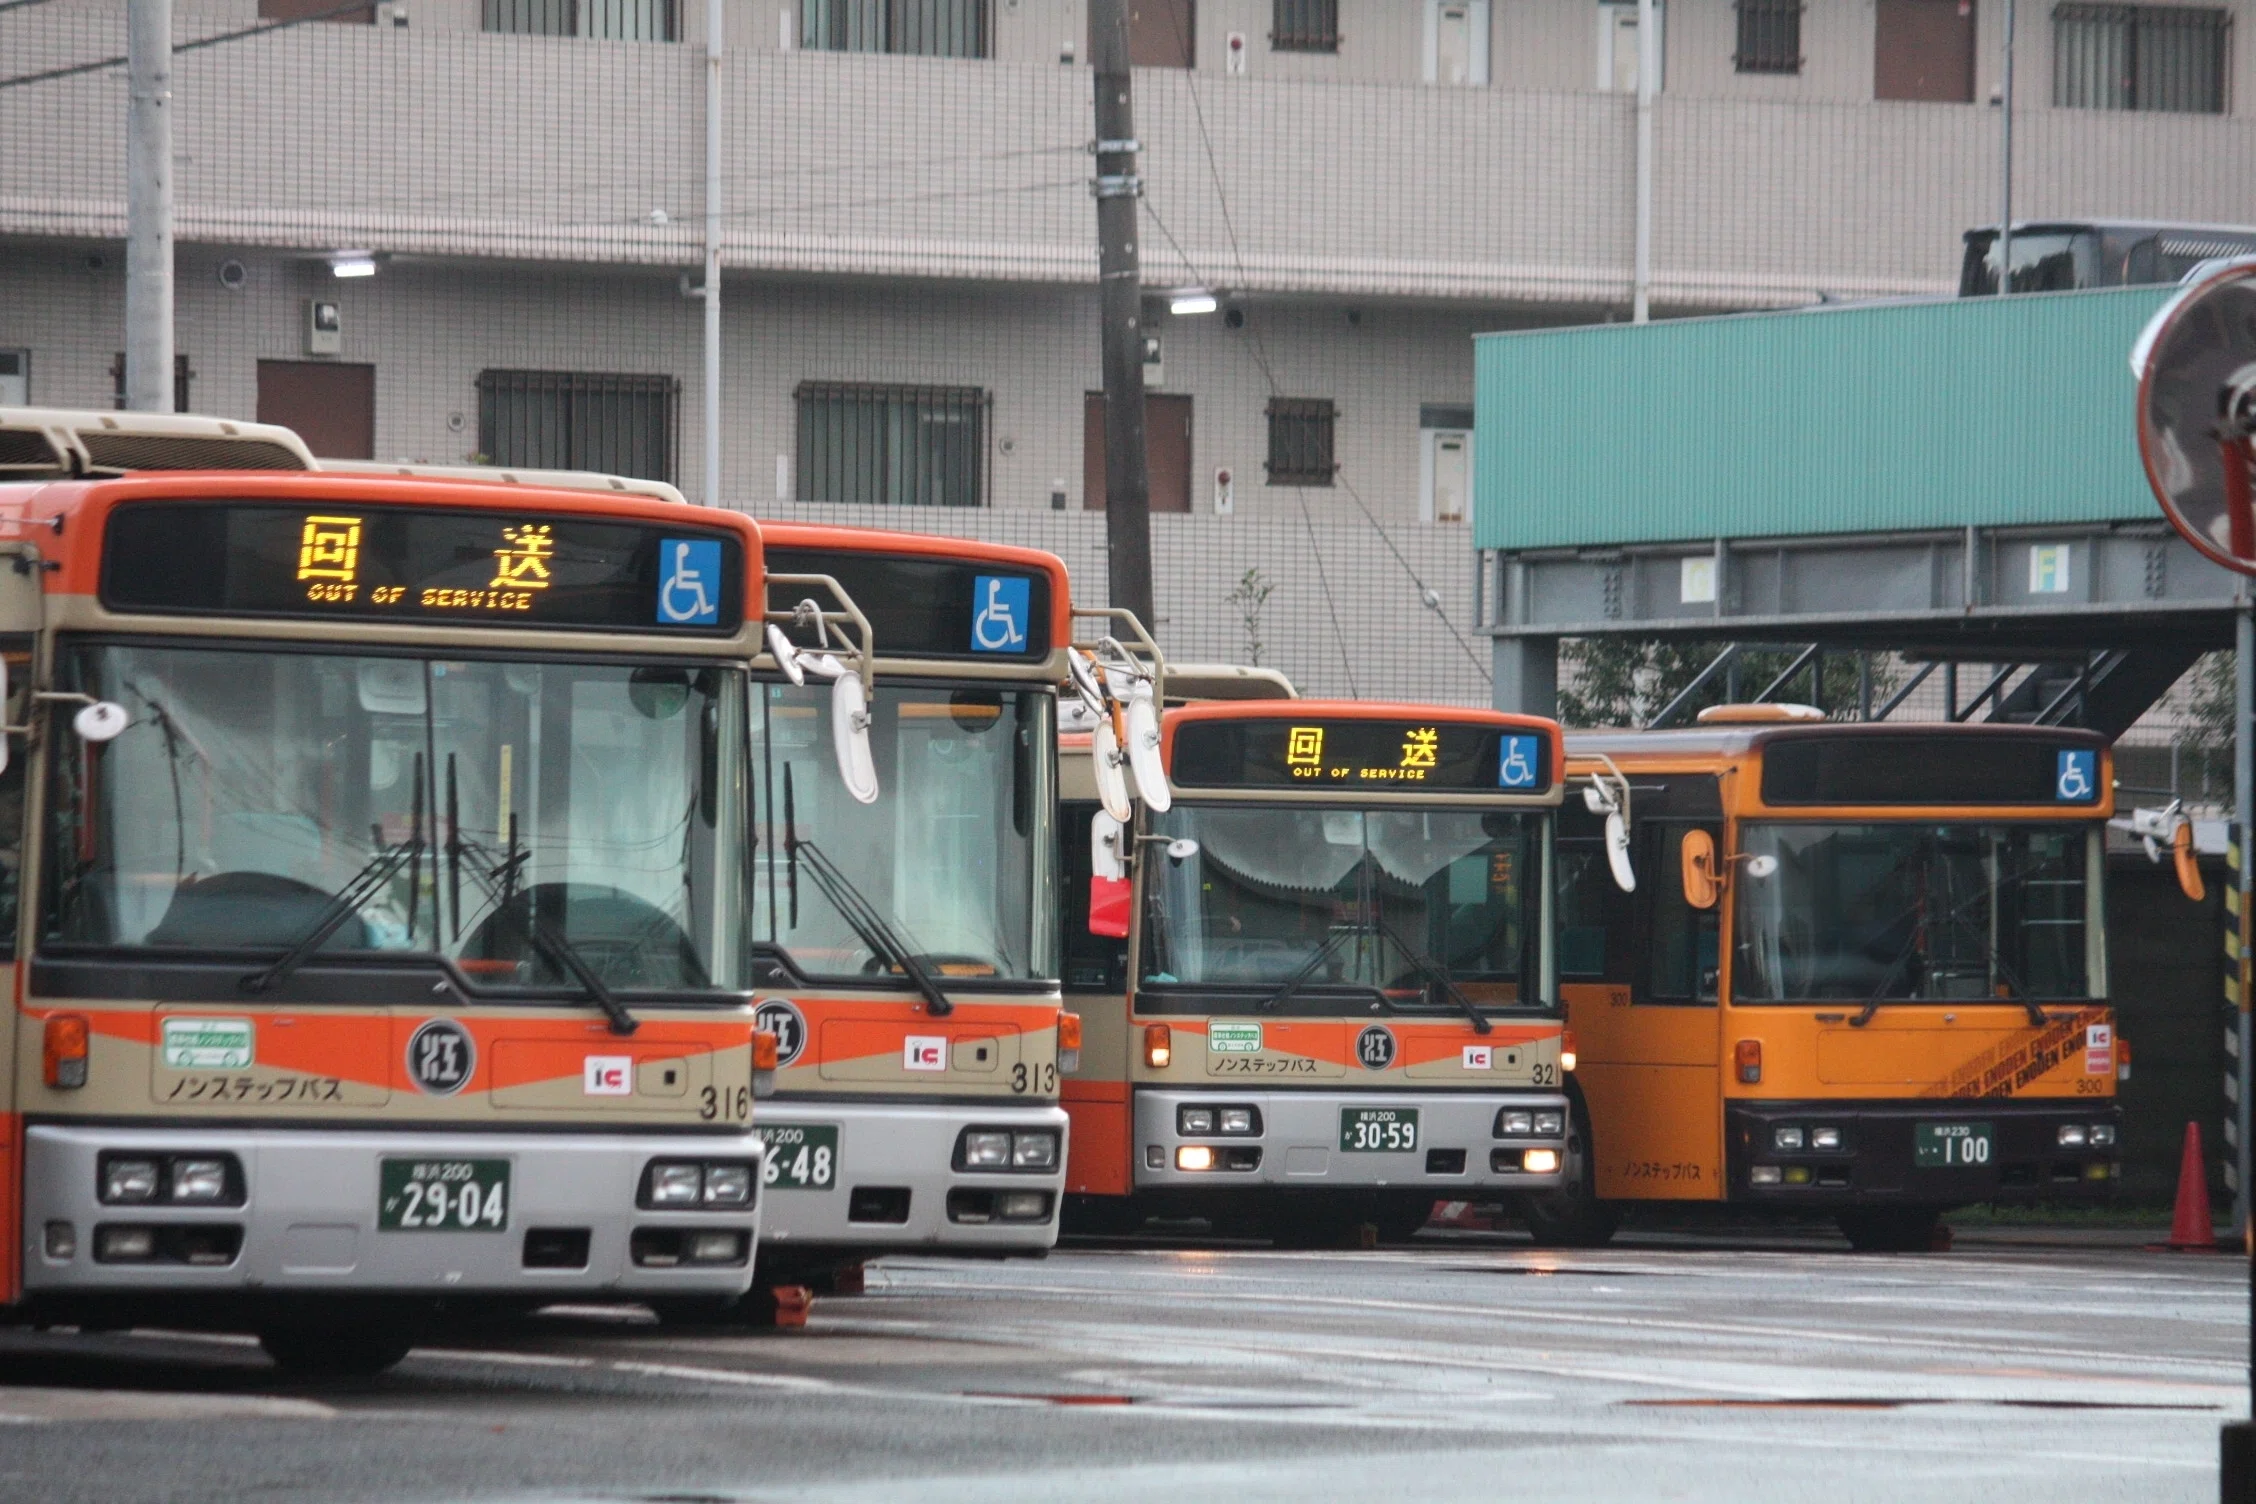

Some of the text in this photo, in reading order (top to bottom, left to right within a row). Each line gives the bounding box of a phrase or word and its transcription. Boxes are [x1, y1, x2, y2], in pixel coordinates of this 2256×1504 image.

[307, 583, 531, 610] OUT OF SERVICE
[1293, 767, 1425, 780] OUT OF SERVICE
[1011, 1063, 1055, 1093] 313
[1215, 1058, 1317, 1073] ノンステップバス
[168, 1076, 343, 1100] ノンステップバス
[2076, 1079, 2103, 1094] 300
[700, 1085, 748, 1120] 316
[1354, 1122, 1414, 1149] 30-59
[763, 1145, 831, 1185] 6-48
[1623, 1162, 1700, 1179] ノンステップバス
[401, 1181, 504, 1227] 29-04
